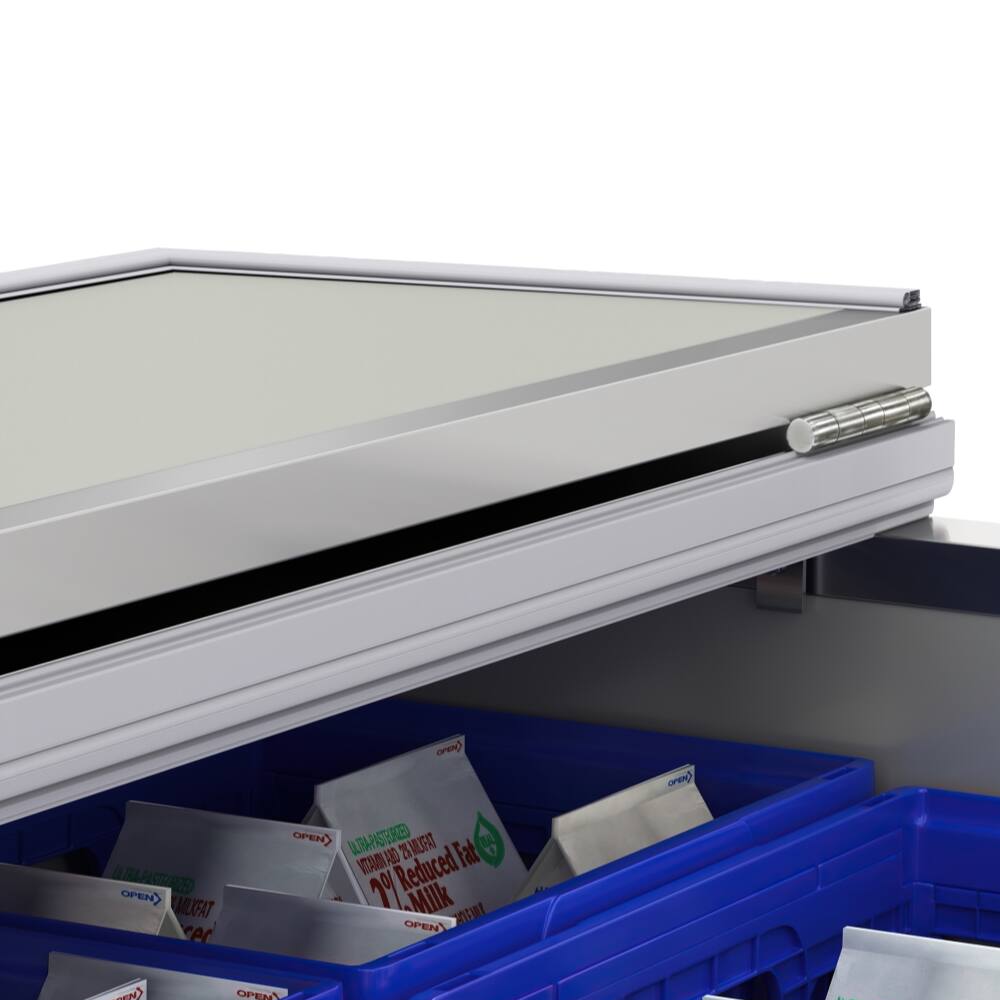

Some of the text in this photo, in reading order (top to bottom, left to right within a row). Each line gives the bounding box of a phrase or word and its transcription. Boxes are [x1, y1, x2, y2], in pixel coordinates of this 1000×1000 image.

[437, 745, 458, 756] OPEN
[667, 773, 689, 788] OPEN
[293, 831, 325, 843] OPEN
[393, 846, 459, 891] Reduced
[452, 838, 480, 868] Fat
[121, 890, 155, 902] OPEN
[406, 882, 454, 914] Milk
[404, 919, 440, 932] OPEN
